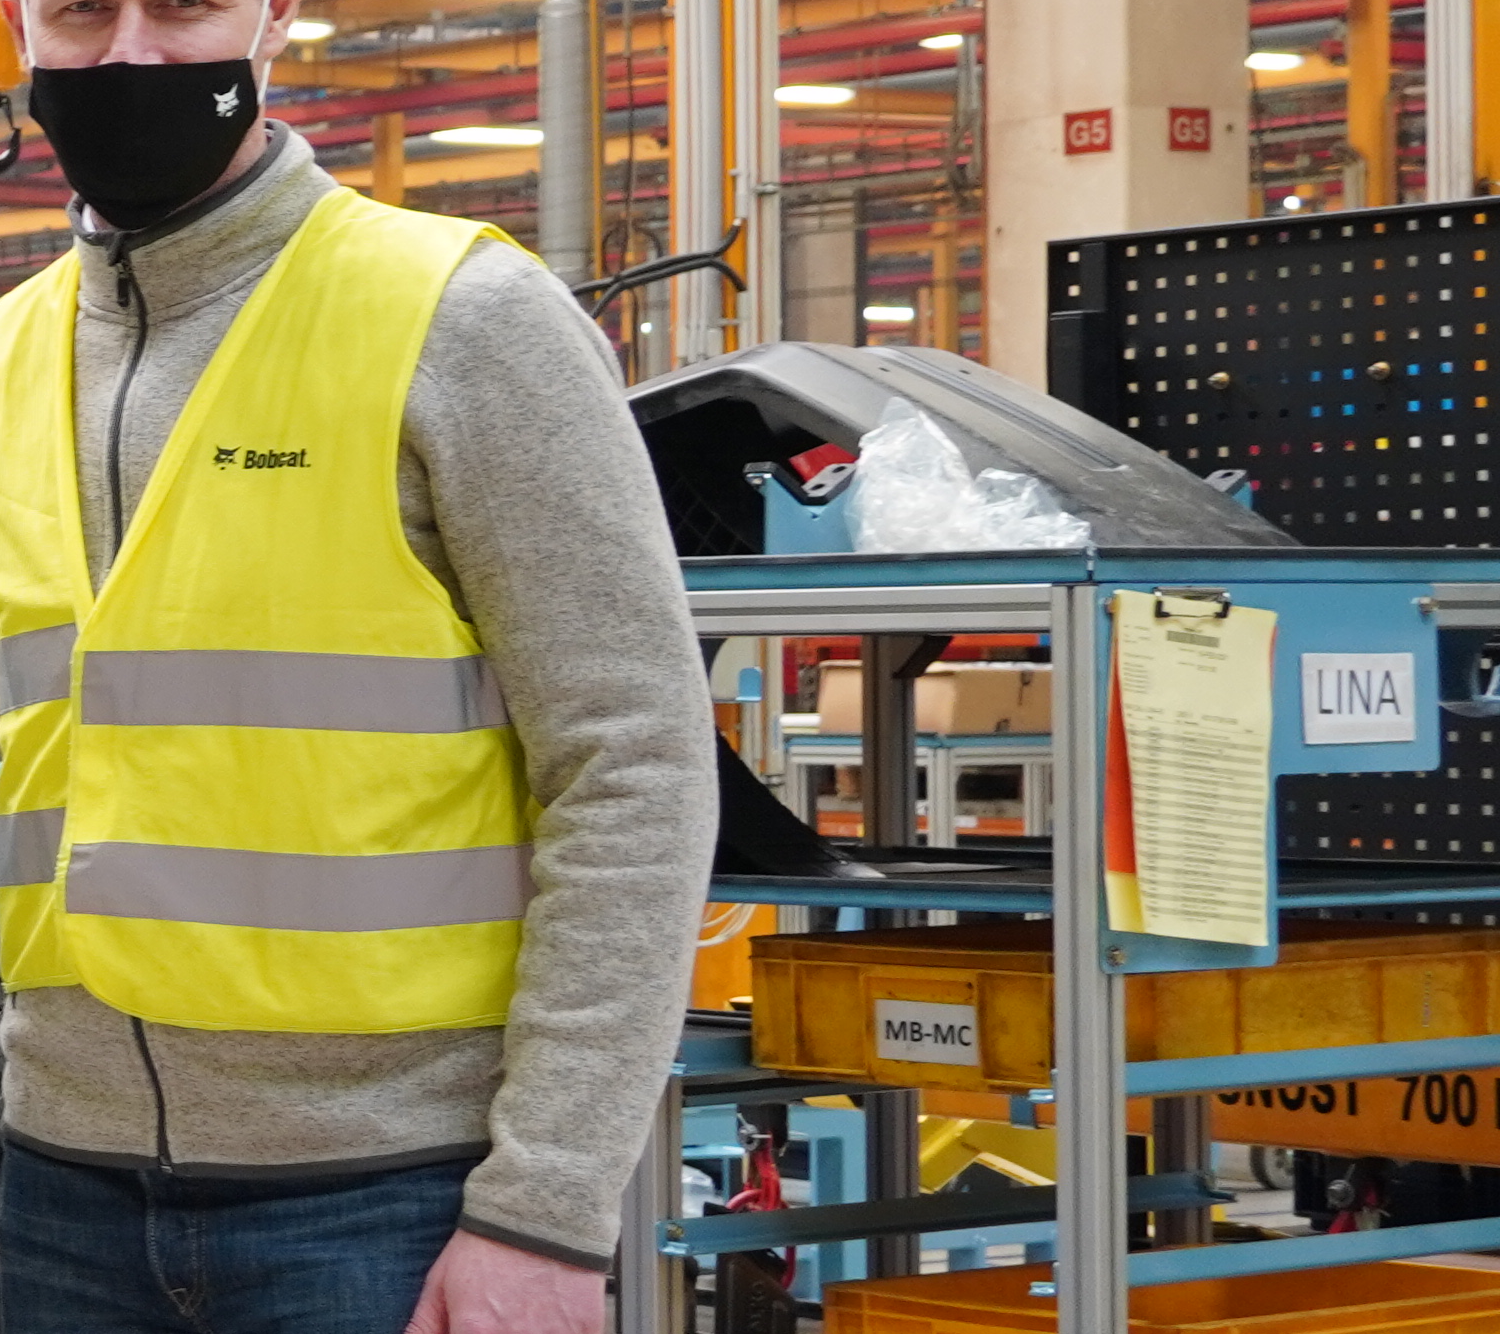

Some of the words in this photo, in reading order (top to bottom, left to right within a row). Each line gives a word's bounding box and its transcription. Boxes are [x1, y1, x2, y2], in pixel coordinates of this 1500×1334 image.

[1068, 119, 1107, 148] G5
[1173, 116, 1206, 144] G5
[1317, 668, 1402, 716] LINA
[884, 1019, 973, 1047] MB-MC
